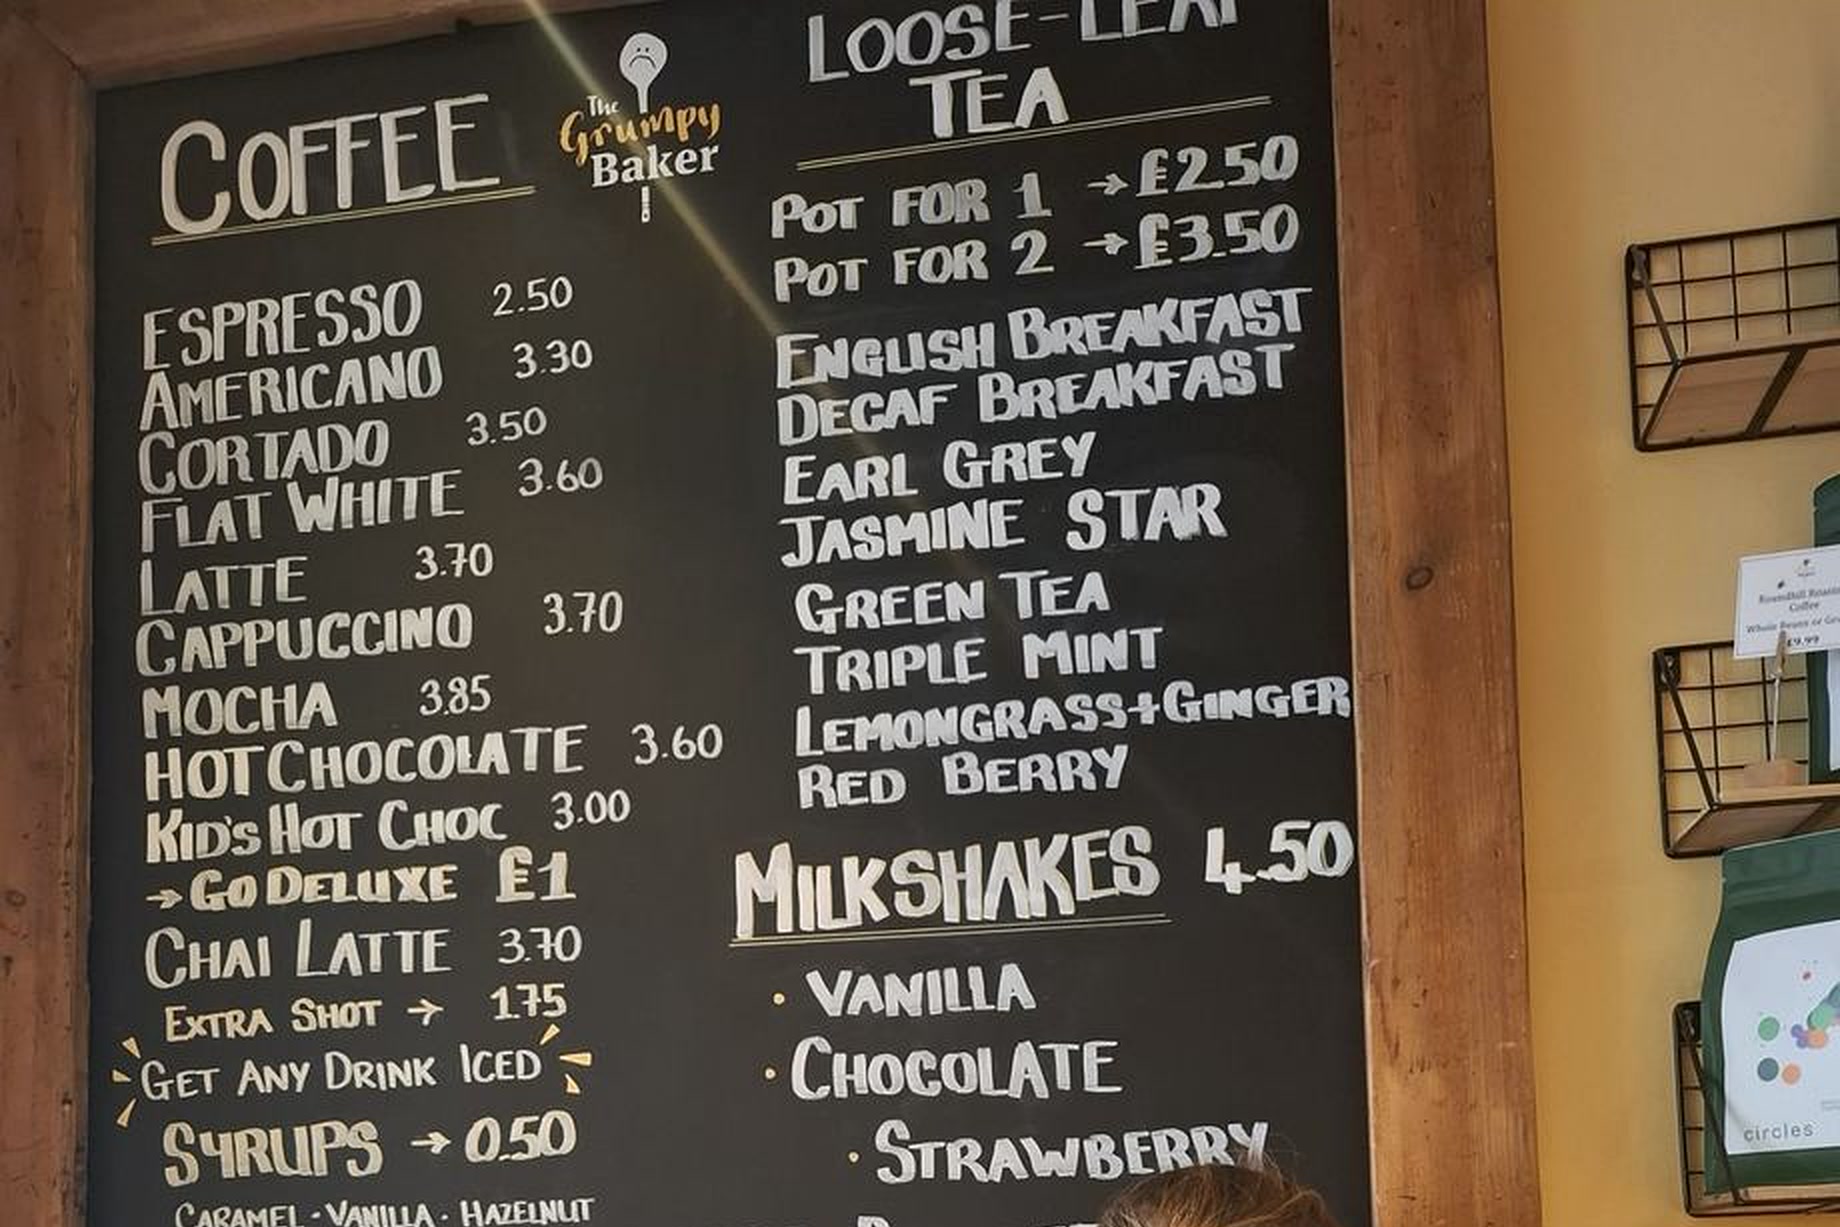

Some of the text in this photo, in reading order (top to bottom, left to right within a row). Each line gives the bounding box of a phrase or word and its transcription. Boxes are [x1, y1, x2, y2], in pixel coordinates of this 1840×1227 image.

[560, 103, 721, 167] Grumpy
[587, 95, 620, 117] The
[909, 66, 1070, 139] TEA
[161, 94, 500, 234] COFFEE
[591, 144, 719, 188] Baker
[771, 134, 1299, 239] POT FOR 1 £2.50
[773, 203, 1300, 303] POT FOR 2 £3.50
[143, 277, 573, 371] ESPRESSO 2.50
[776, 287, 1313, 390] ENGLISH BREAKFAST
[139, 339, 593, 431] AMERICANO 3.30
[777, 343, 1295, 447] DECAF BREAKFAST
[138, 407, 547, 495] CORTADO 3.50
[784, 430, 1096, 504] EARL GREY
[141, 457, 603, 552] FLAT WHITE 3.60
[781, 482, 1229, 568] JASMINE STAR
[141, 542, 494, 616] LATTE 3.70
[795, 571, 1110, 634] GREEN TEA
[134, 590, 624, 677] CAPPUCCINO 3.70
[794, 626, 1164, 696] TRIPLE MINT
[142, 675, 492, 739] MOCHA 3.85
[145, 722, 724, 802] HOT CHOCOLATE 3.60
[798, 744, 1130, 808] RED BERRY
[268, 803, 363, 856] HOT
[377, 800, 508, 852] CHOC
[552, 788, 632, 832] 3.00
[190, 845, 577, 912] GO DELUXE £1
[734, 820, 1355, 940] MILKSHAKES 4.50
[145, 918, 583, 990] CHAI LATTE 3.70
[164, 1004, 274, 1043] EXTRA
[290, 997, 383, 1033] SHOT
[805, 963, 1037, 1018] VANILLA
[141, 1043, 542, 1101] GET ANY DRINK ICED
[791, 1036, 1123, 1100] CHOCOLATE
[162, 1110, 577, 1188] SYRUPS 0.50
[875, 1119, 1269, 1184] STRAWBERRY
[1744, 1122, 1814, 1143] circles
[460, 1198, 595, 1227] HAZELNUT
